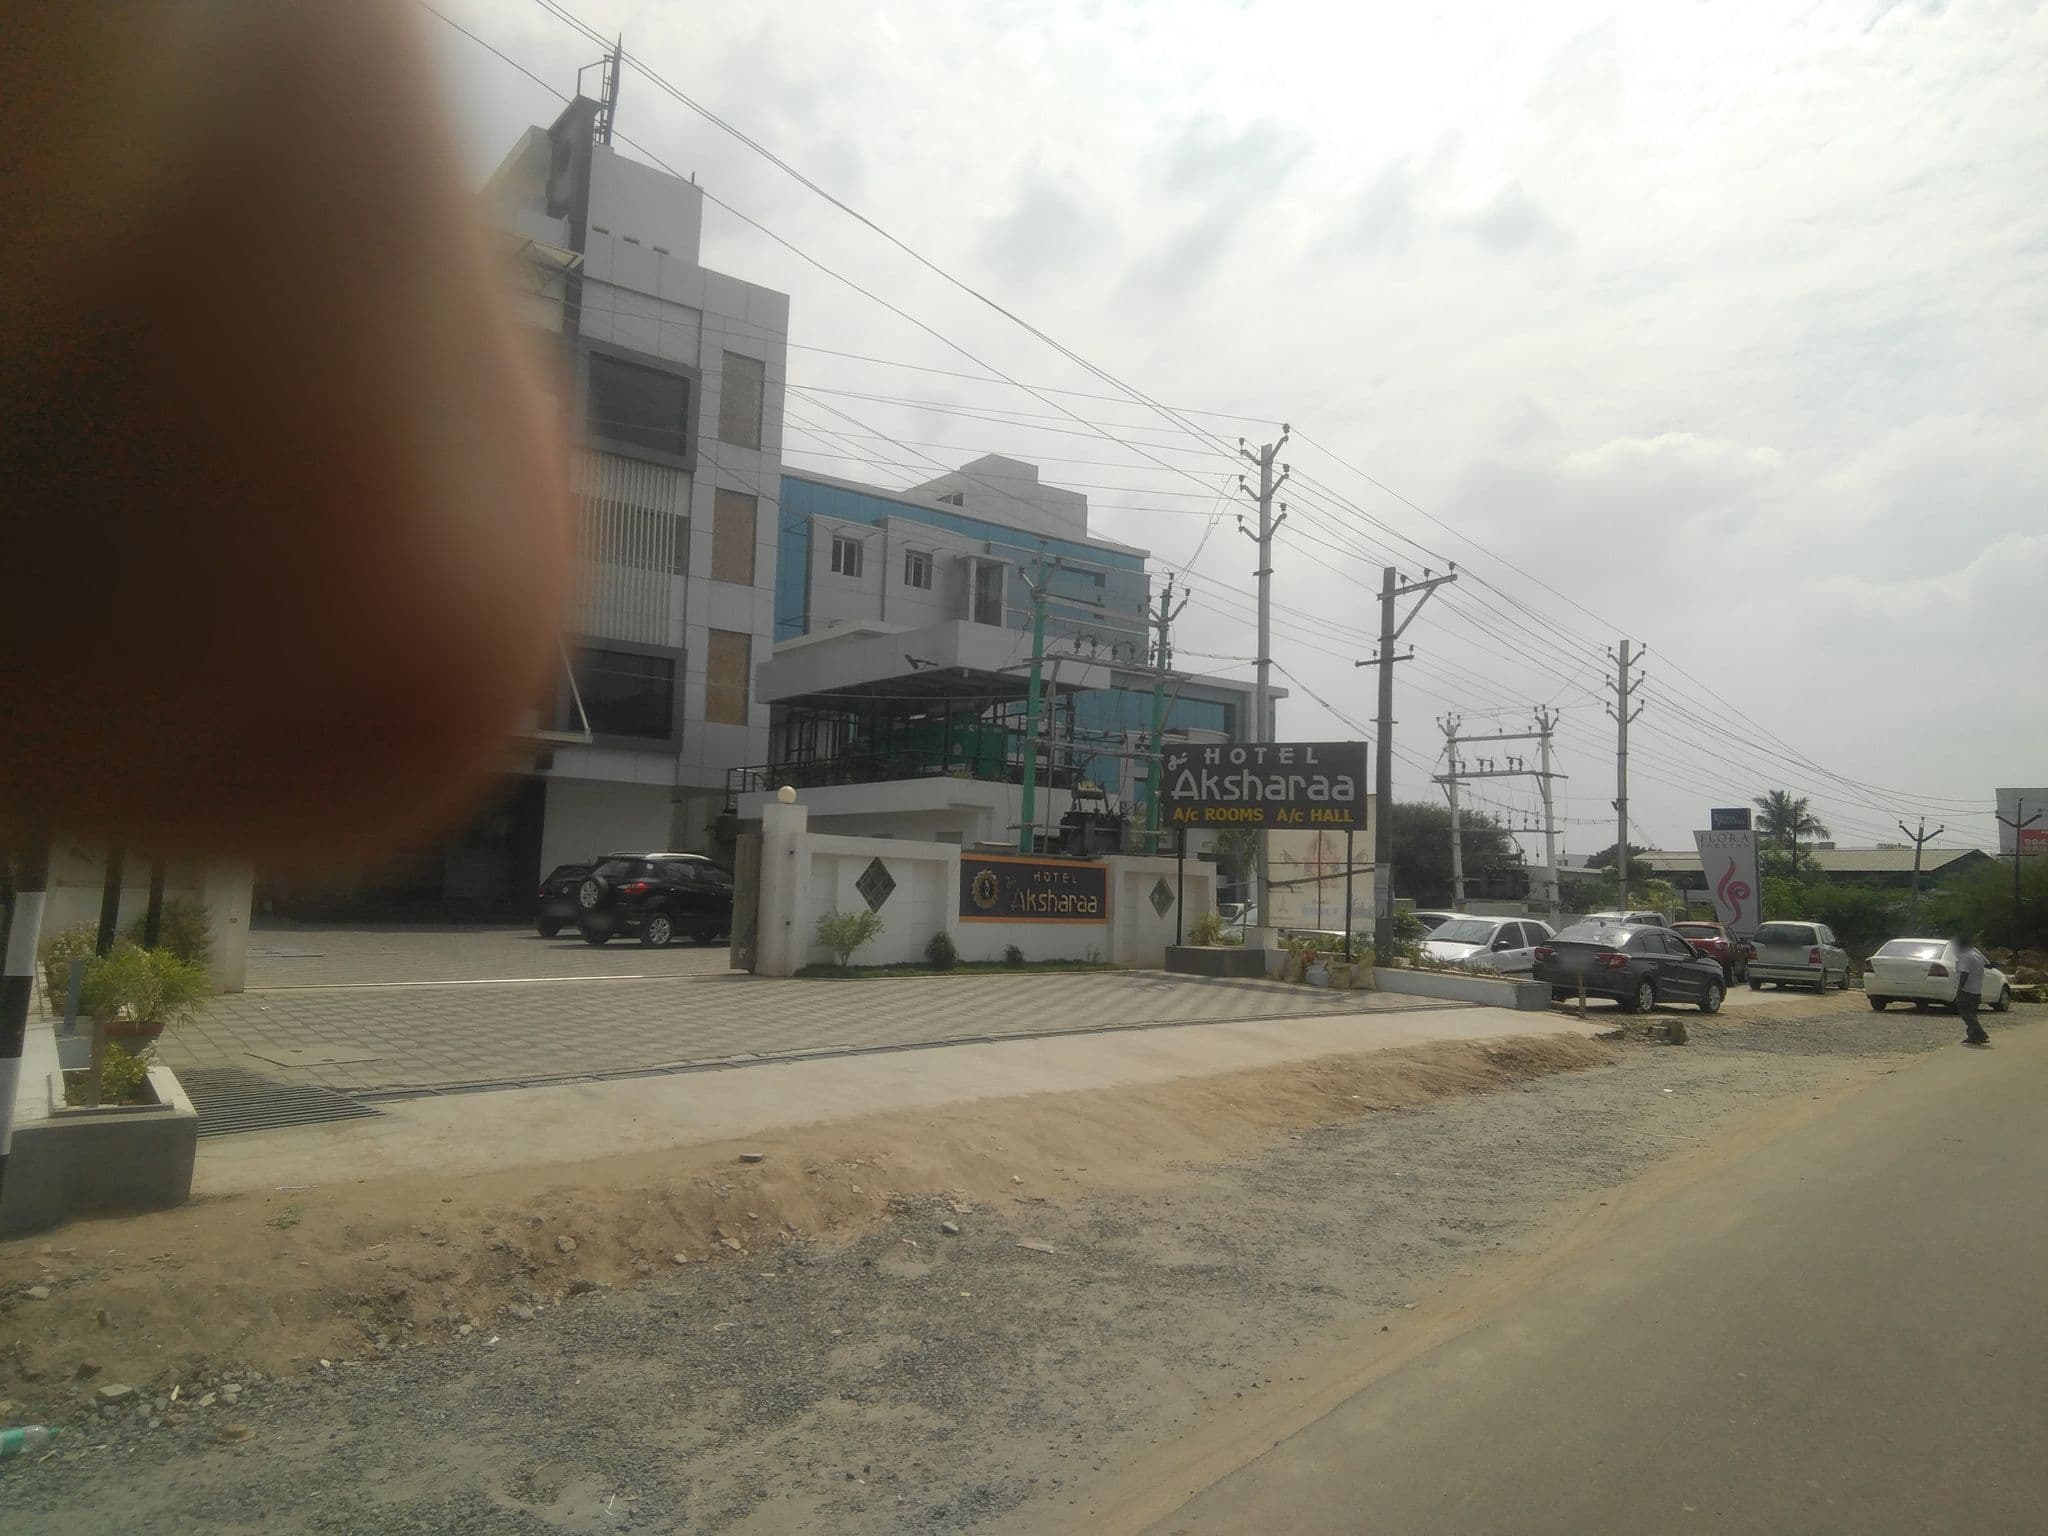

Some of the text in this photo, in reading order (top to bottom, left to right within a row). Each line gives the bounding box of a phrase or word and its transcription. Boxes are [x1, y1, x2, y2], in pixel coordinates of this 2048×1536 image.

[1204, 747, 1318, 764] HOTEL
[1171, 769, 1354, 801] Aksharaa
[1173, 807, 1355, 824] A/c ROOMS A/c HALL
[1033, 871, 1078, 884] HOTEL
[1010, 888, 1098, 913] Aksharaa
